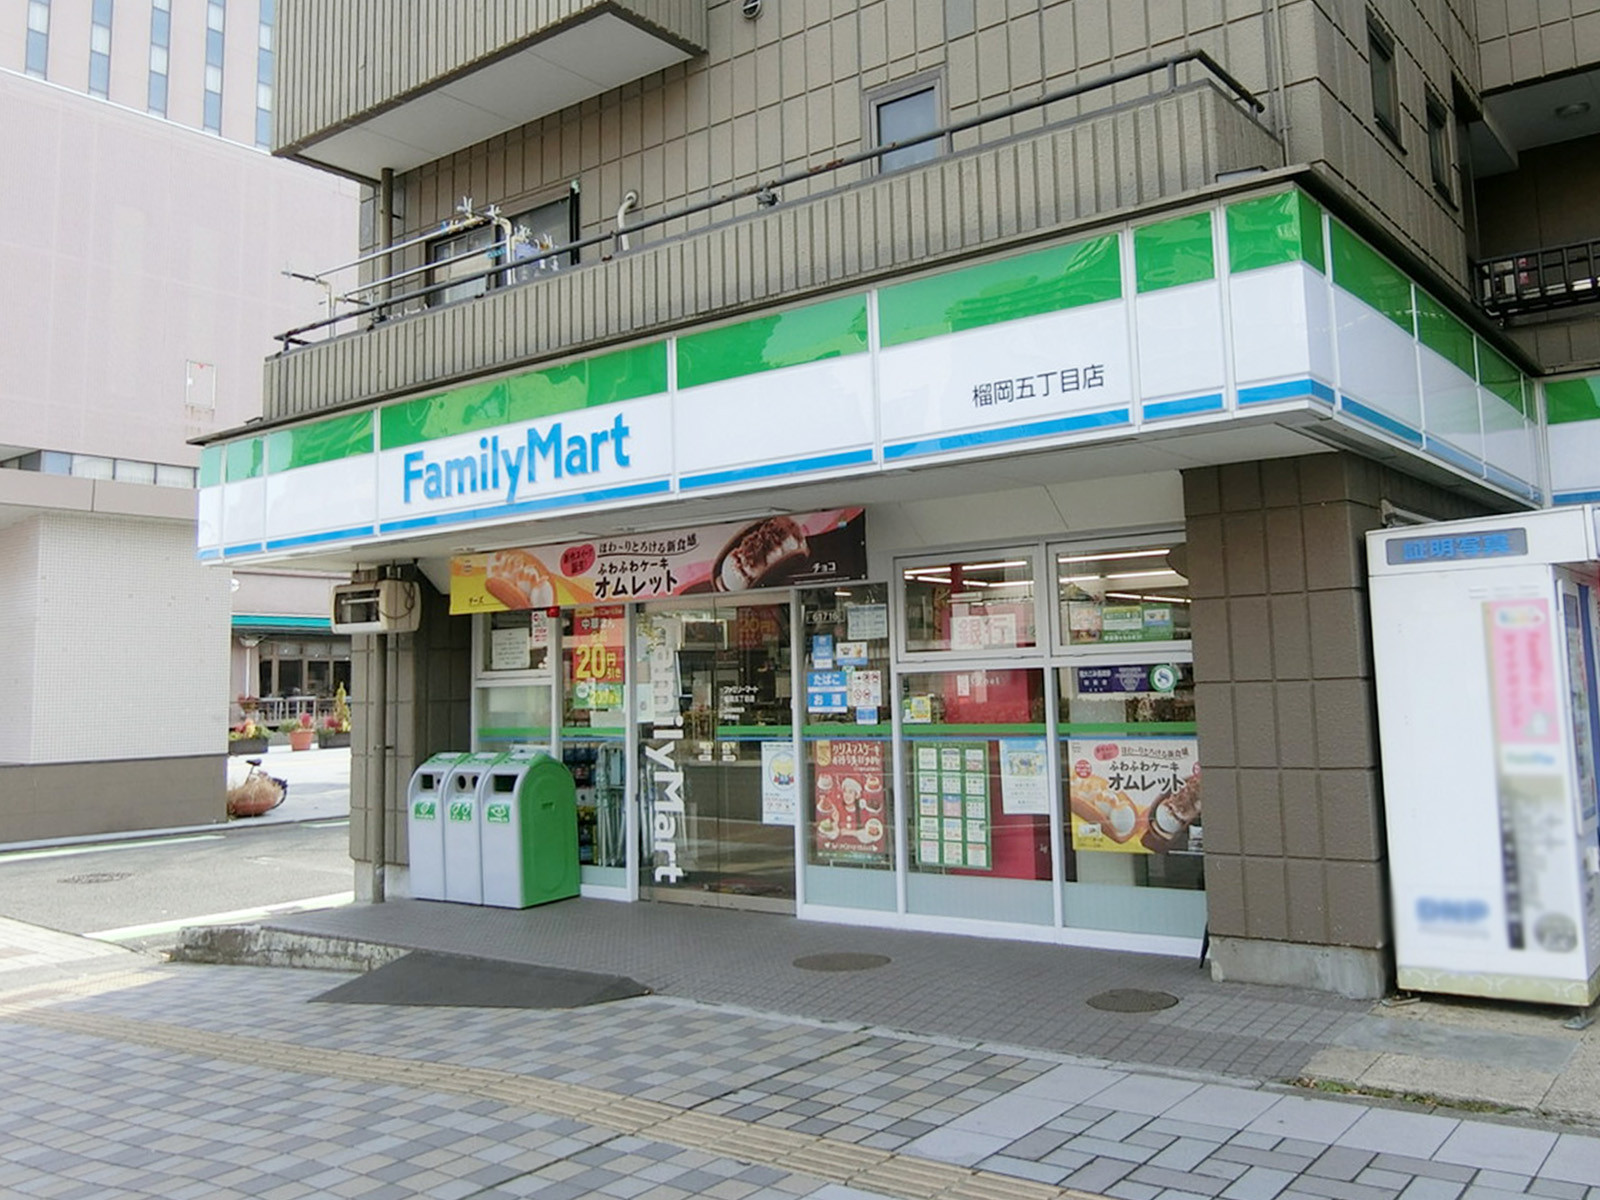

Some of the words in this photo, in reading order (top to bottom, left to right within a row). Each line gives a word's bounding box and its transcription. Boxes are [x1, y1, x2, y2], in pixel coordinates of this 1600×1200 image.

[972, 364, 1104, 407] 榴岡五丁目店
[403, 413, 631, 504] FamilyMart
[598, 557, 669, 576] ふわふわケーキ
[594, 569, 677, 598] オムレット
[813, 674, 840, 686] たばこ
[832, 742, 880, 757] クリスマスケーキ
[1109, 761, 1180, 773] ふわふわケーキ
[1108, 773, 1185, 792] オムレット
